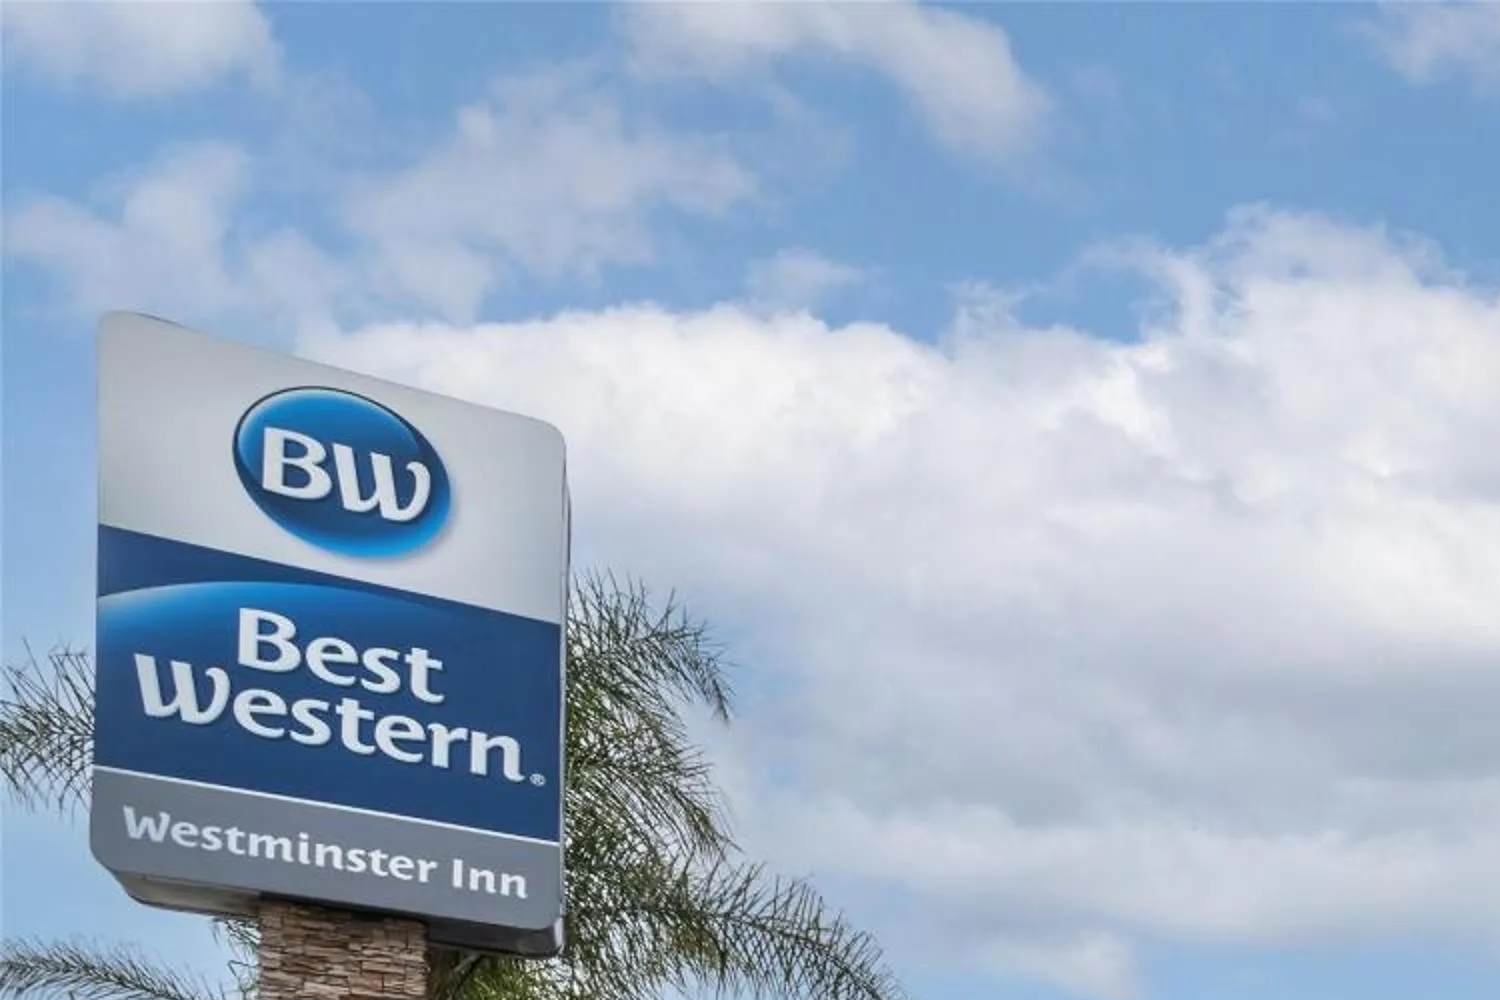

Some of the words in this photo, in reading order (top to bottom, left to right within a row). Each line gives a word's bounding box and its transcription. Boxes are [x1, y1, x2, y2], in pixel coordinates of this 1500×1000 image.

[261, 426, 431, 522] BW
[237, 606, 445, 704] Best
[122, 805, 438, 884] Westminster
[452, 857, 528, 900] Inn
